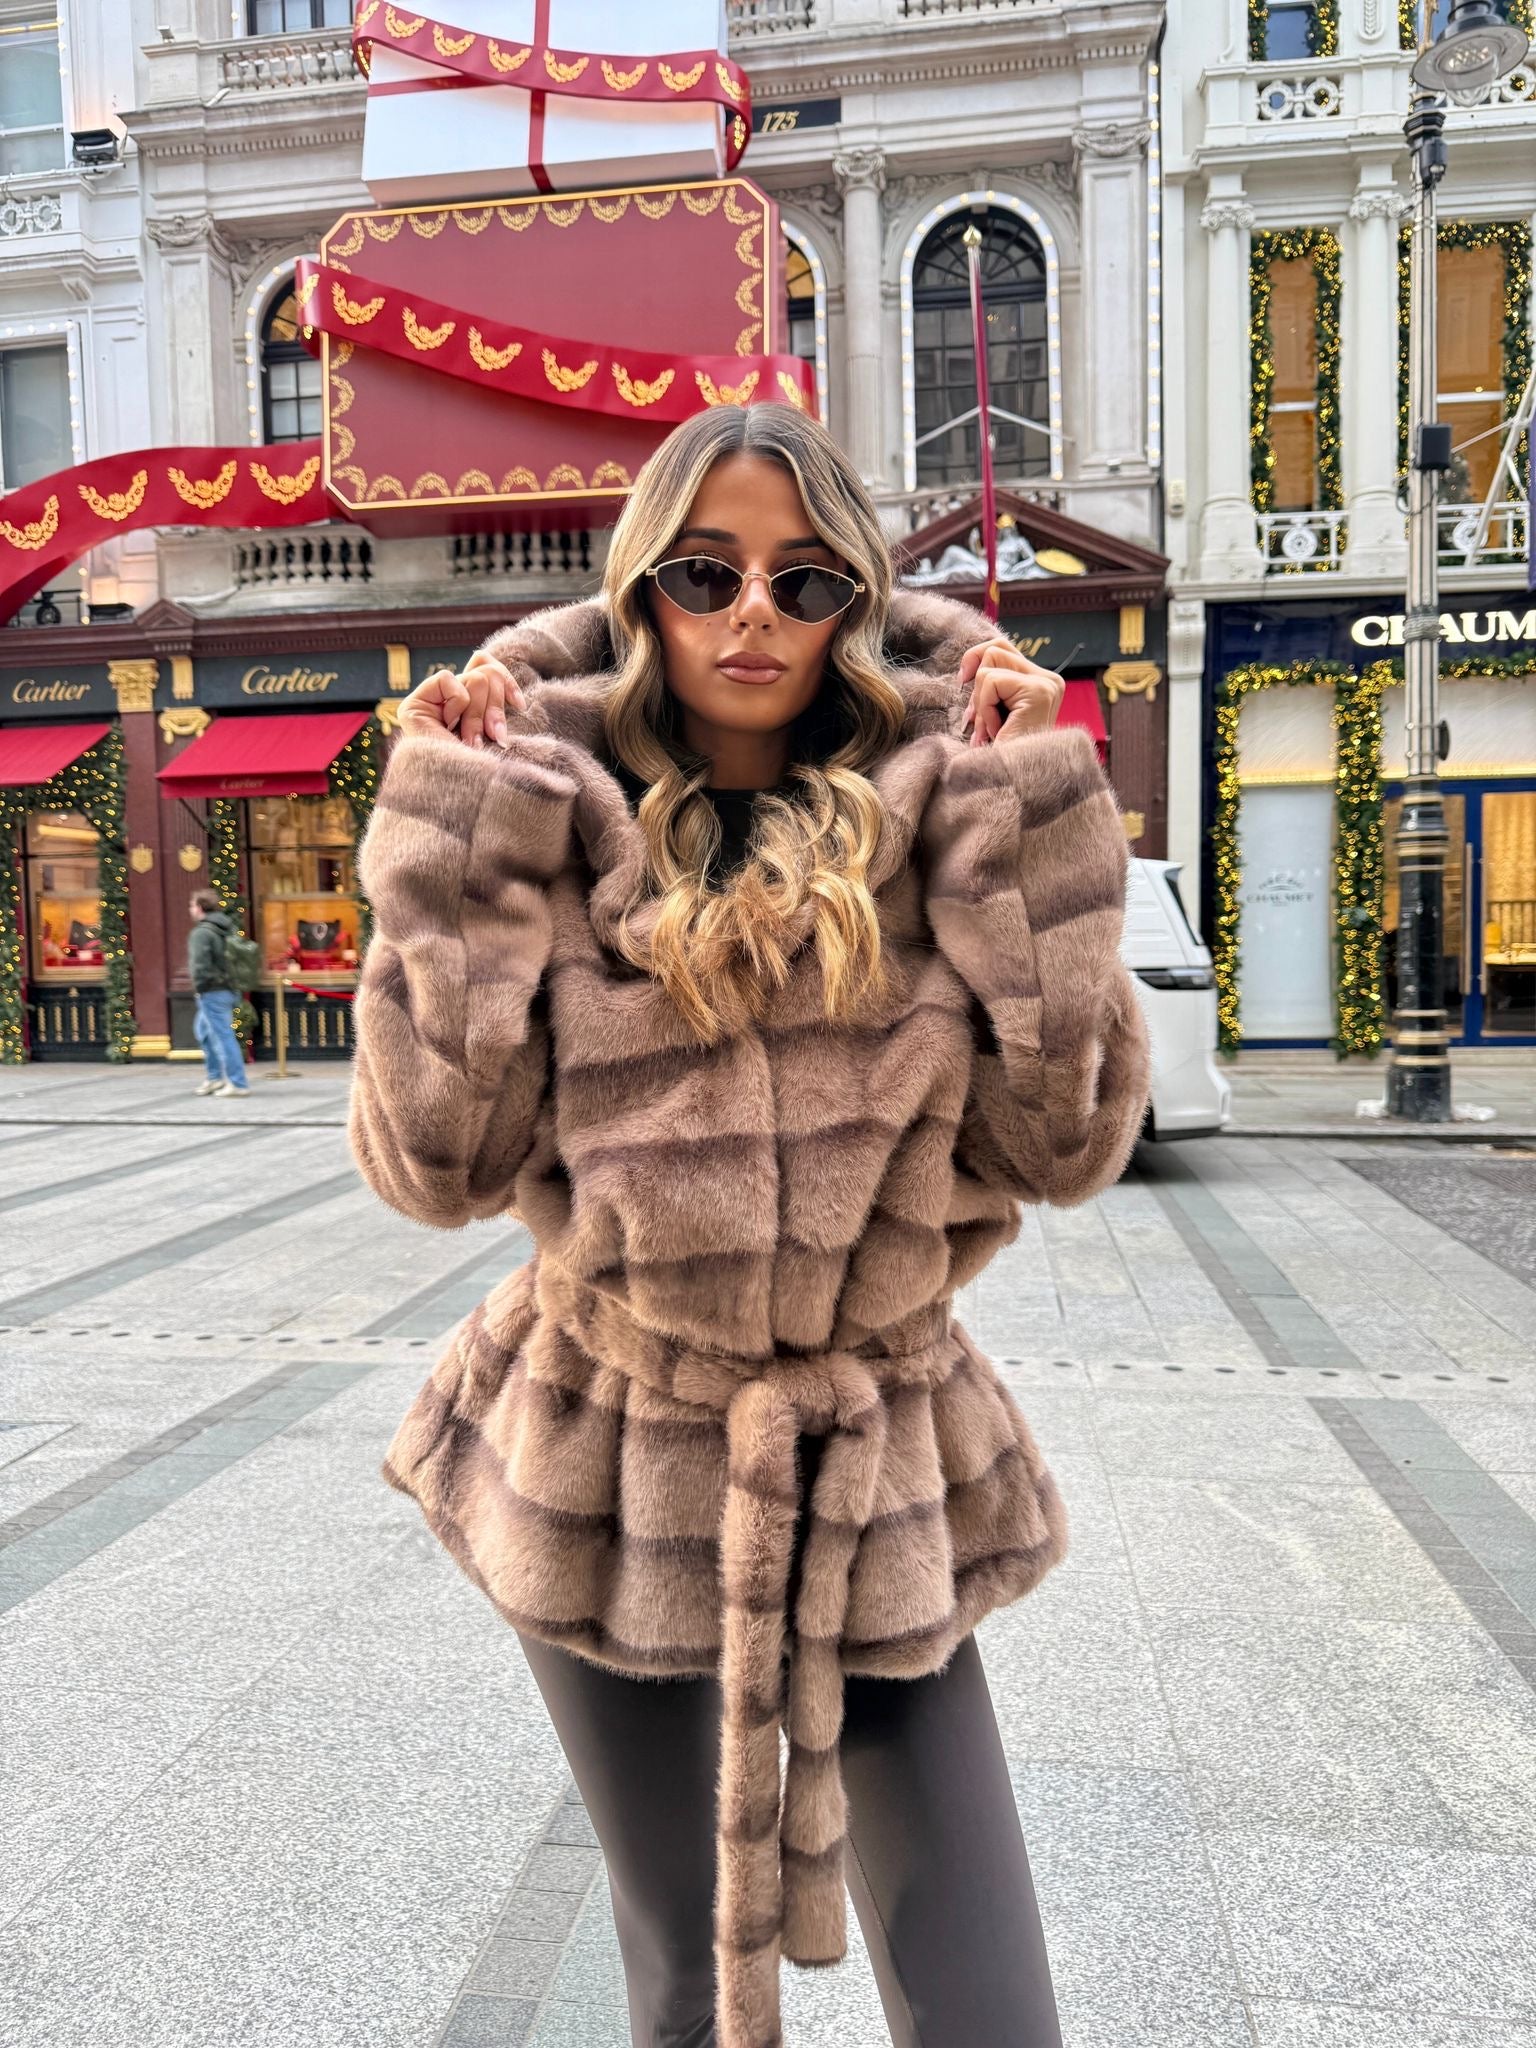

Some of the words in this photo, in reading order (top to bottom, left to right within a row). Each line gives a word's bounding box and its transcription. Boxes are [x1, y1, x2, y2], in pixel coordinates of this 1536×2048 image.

[761, 110, 800, 133] 175
[12, 678, 92, 703] Cartier
[241, 664, 339, 695] Cartier
